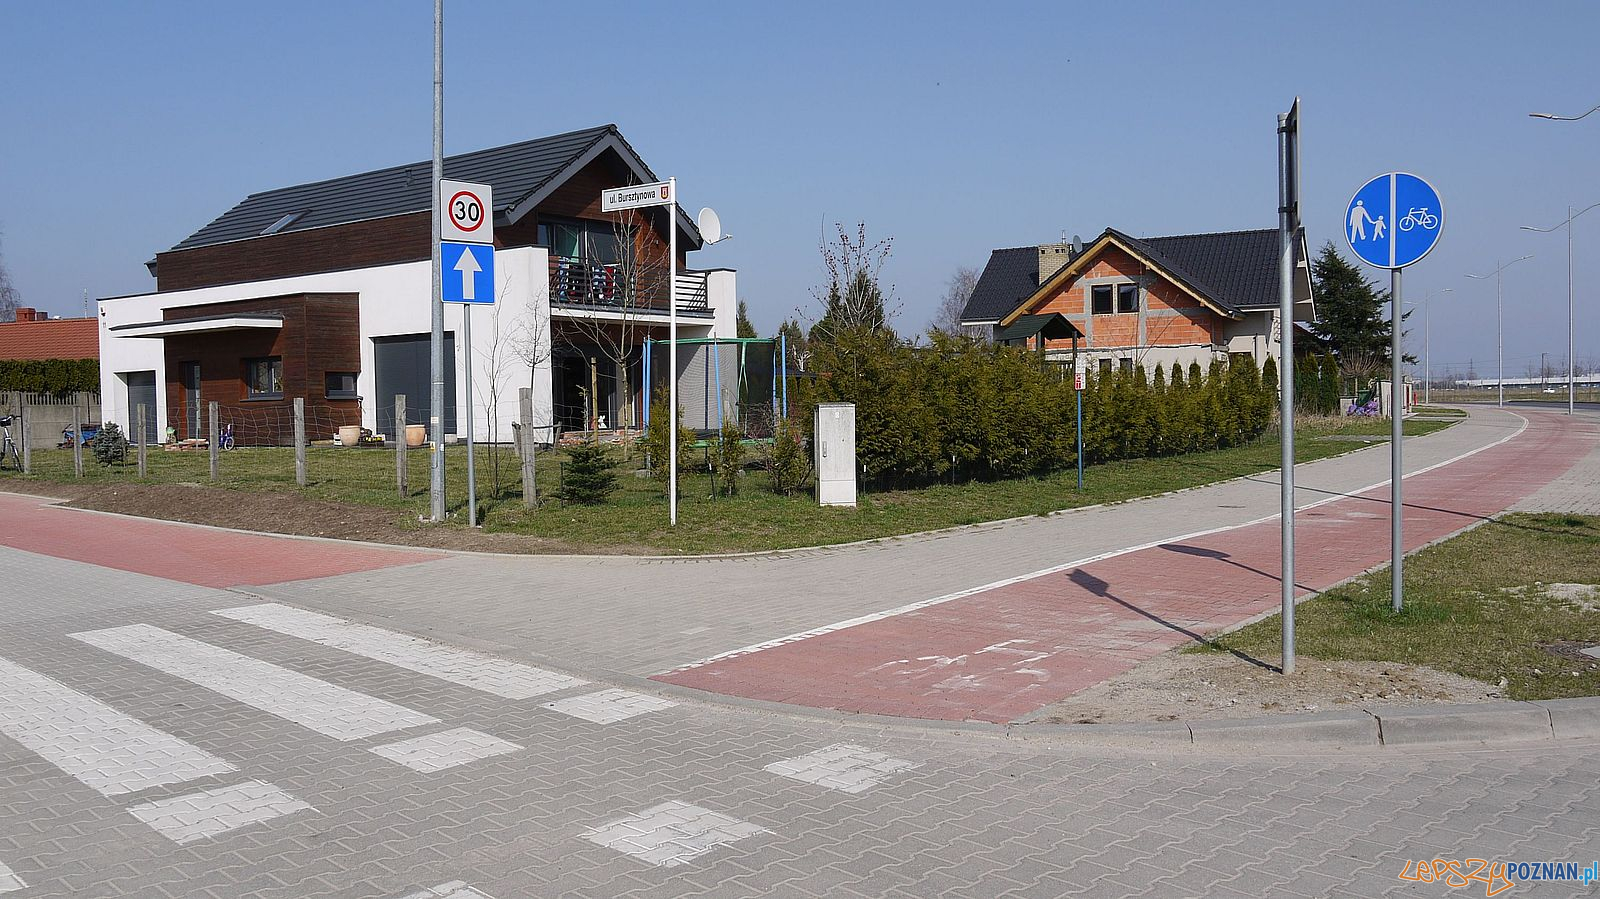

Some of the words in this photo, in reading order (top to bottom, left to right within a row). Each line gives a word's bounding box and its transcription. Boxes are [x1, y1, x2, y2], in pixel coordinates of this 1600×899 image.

[609, 193, 617, 204] ul.
[618, 189, 656, 203] Bursztynowa
[454, 200, 480, 222] 30
